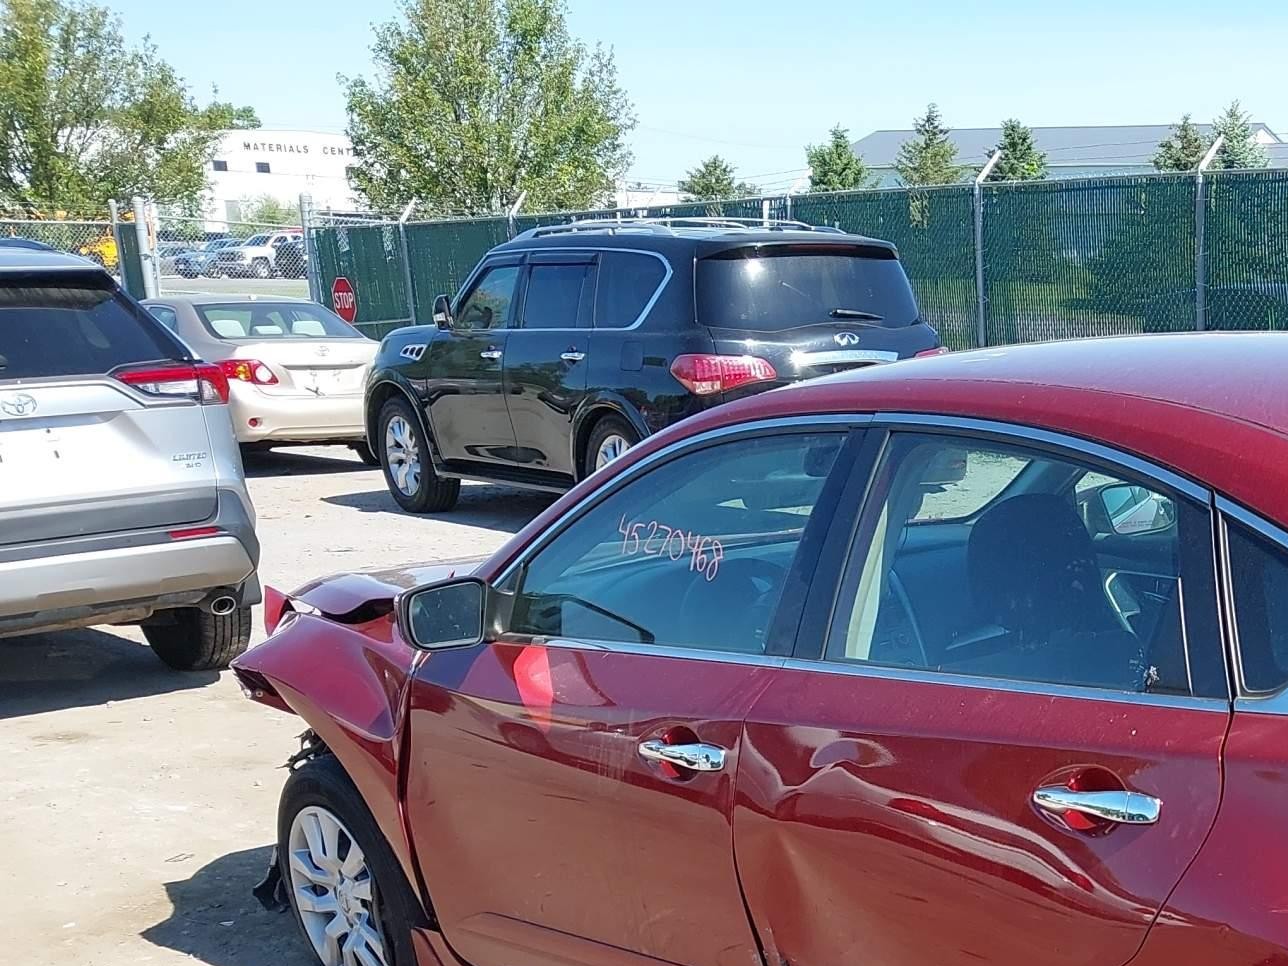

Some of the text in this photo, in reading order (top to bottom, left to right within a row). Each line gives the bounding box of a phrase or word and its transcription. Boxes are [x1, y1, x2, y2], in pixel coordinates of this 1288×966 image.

[243, 142, 309, 154] MATERIALS
[334, 292, 353, 309] STOP
[619, 513, 723, 582] 45270468
